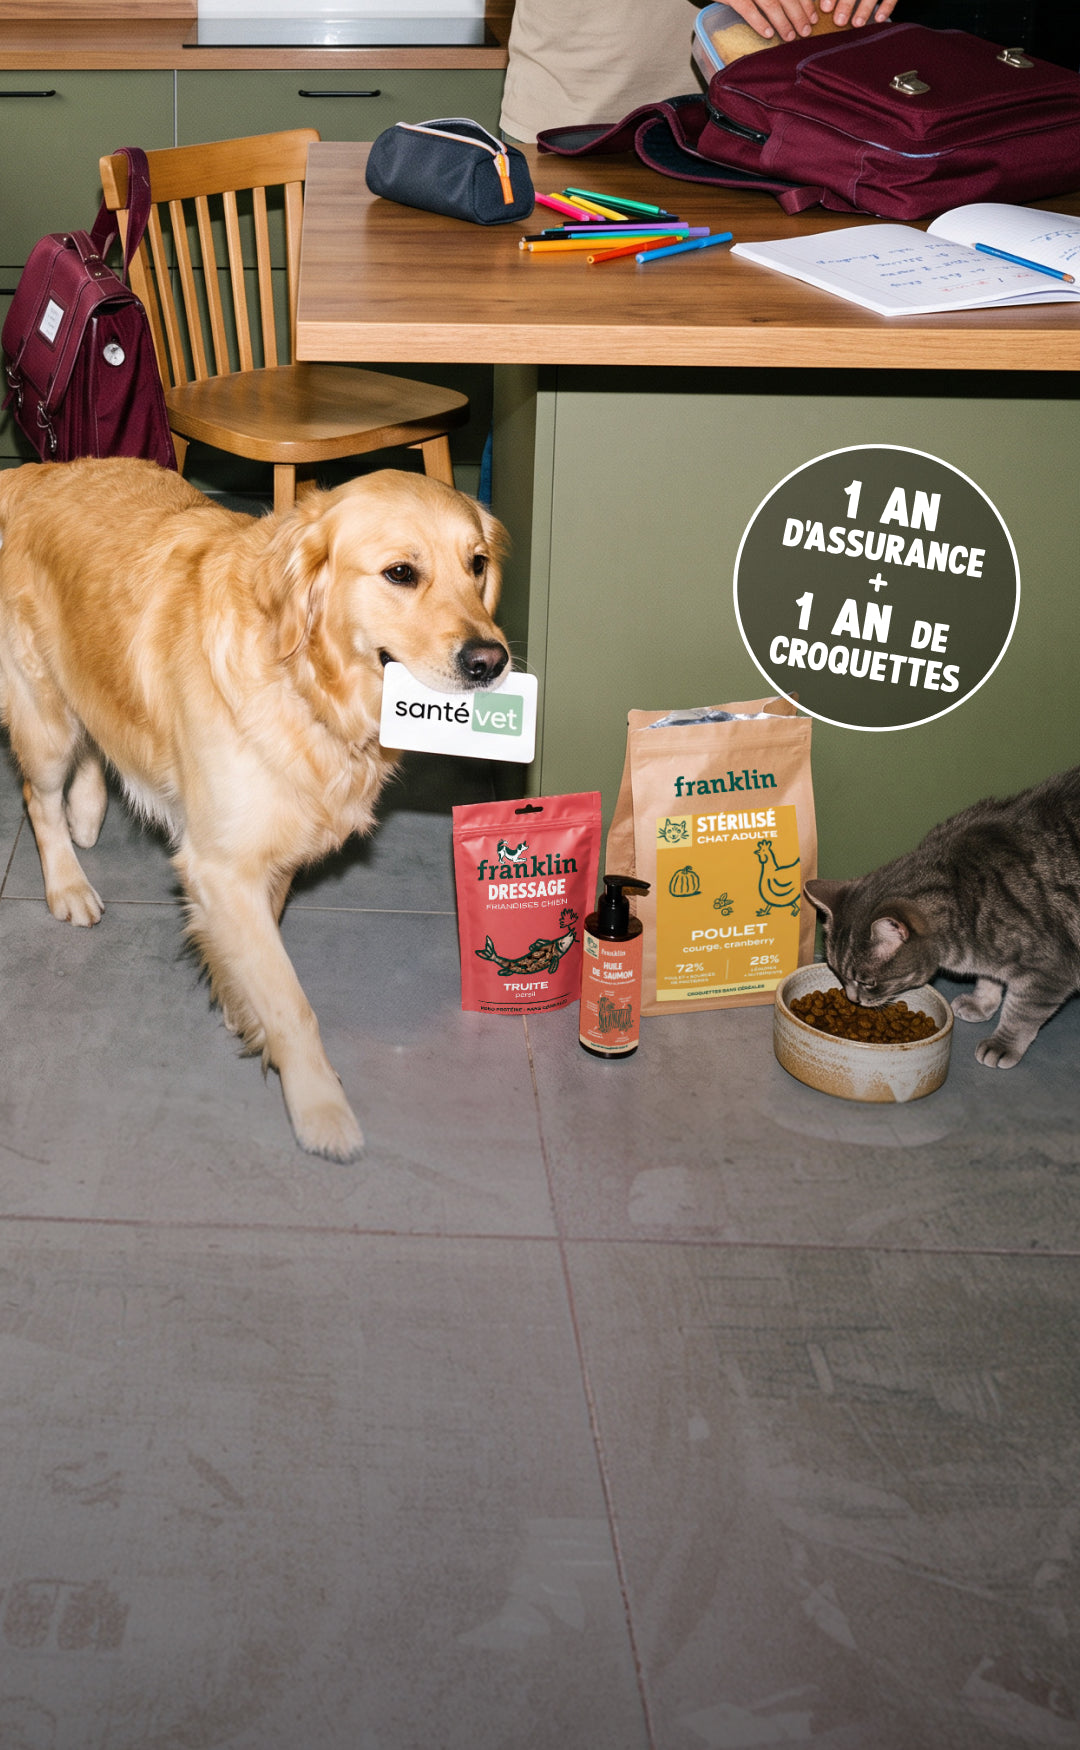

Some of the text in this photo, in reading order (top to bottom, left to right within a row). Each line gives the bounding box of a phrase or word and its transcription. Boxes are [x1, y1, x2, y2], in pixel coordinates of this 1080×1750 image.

[674, 769, 778, 797] franklin
[696, 808, 776, 833] STÉRILISÉ
[697, 830, 778, 845] CHAT ADULTE
[477, 853, 578, 881] franklin
[488, 878, 566, 900] DRESSAGE
[486, 898, 568, 910] FRIANDISES CHIEN
[691, 923, 768, 941] POULET
[724, 937, 775, 949] cranberry
[600, 948, 626, 957] franklin
[603, 962, 623, 970] HUILE
[749, 954, 780, 966] 28%
[592, 967, 601, 977] DE
[603, 969, 633, 980] SAUMON
[675, 962, 705, 973] 72%
[503, 981, 549, 991] TRUITE
[687, 989, 722, 997] CROQUETTES
